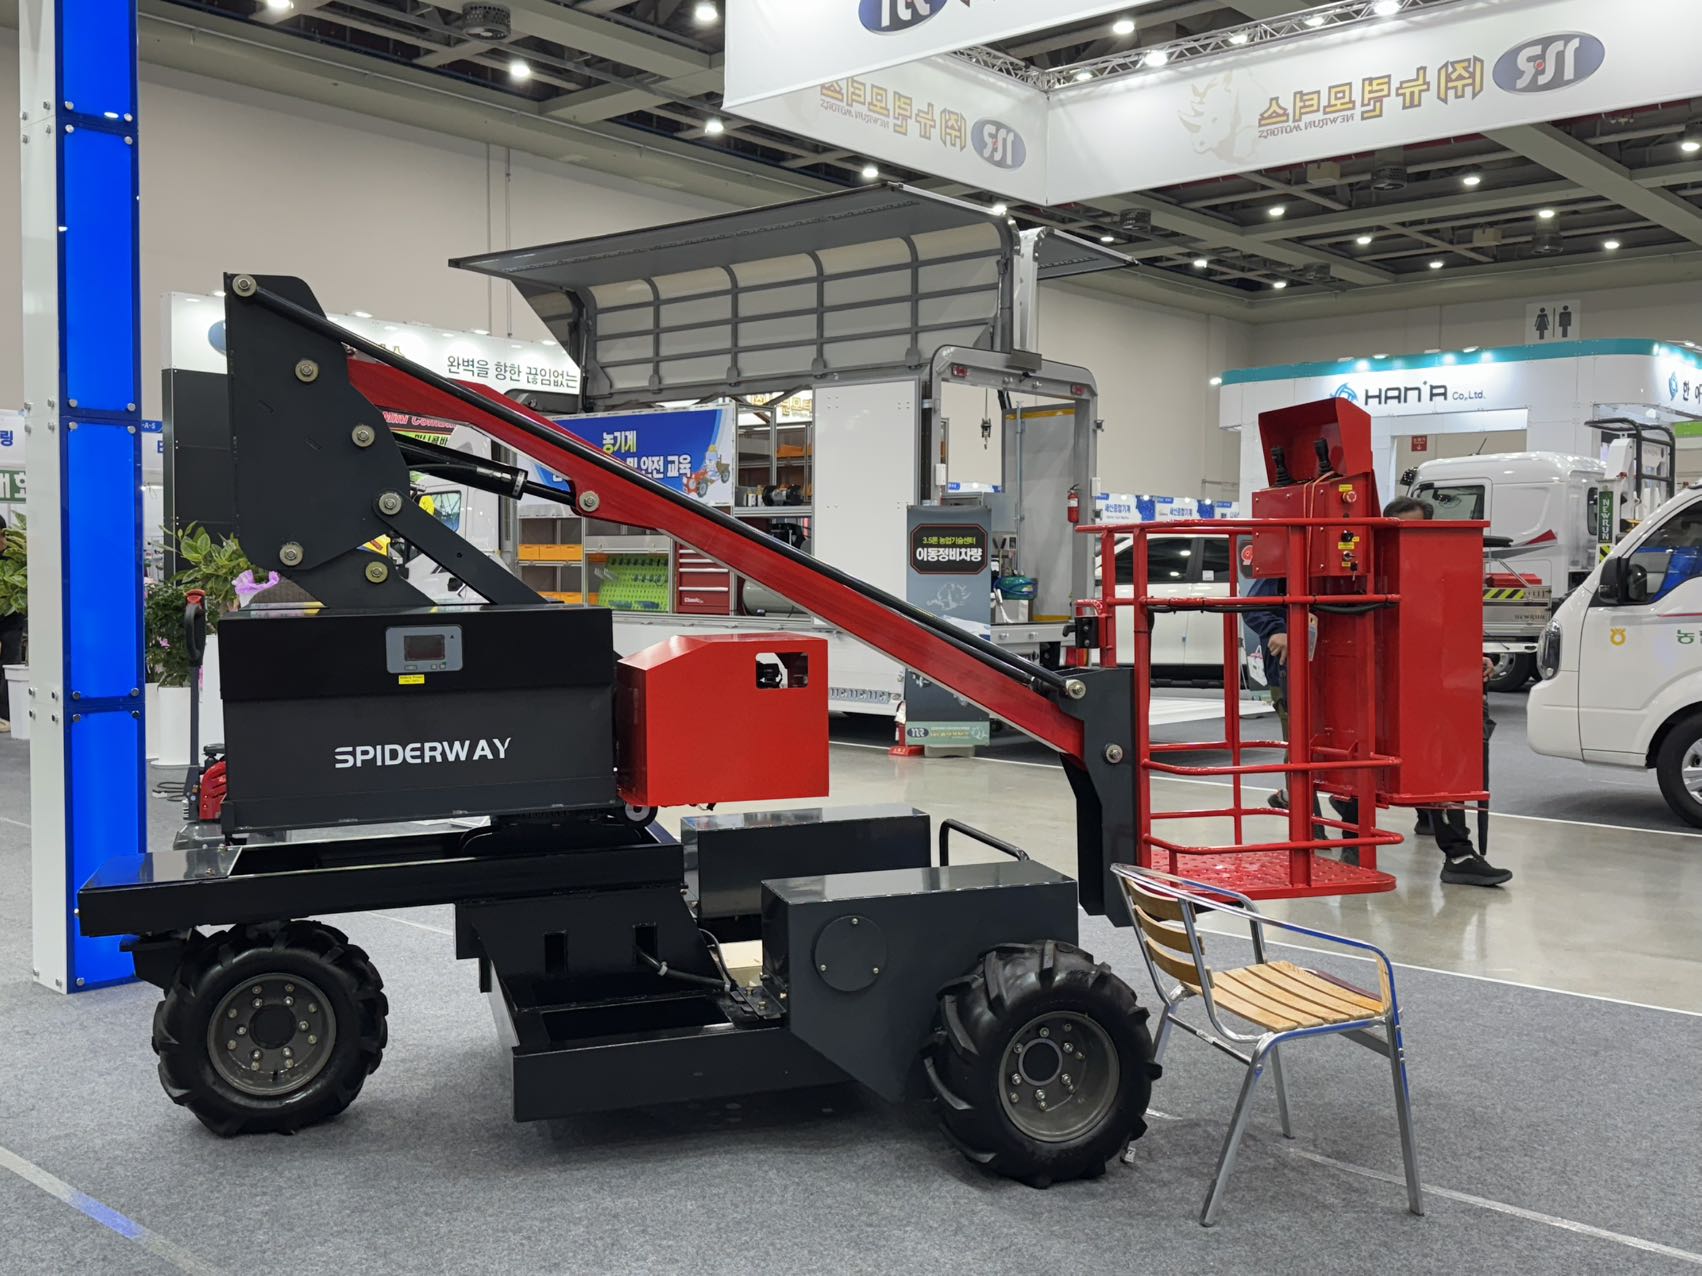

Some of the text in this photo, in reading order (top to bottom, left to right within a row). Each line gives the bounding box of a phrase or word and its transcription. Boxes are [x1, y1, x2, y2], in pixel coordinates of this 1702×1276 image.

[447, 355, 578, 389] 완벽을 향한 끊임없는
[602, 430, 637, 454] 농기계
[640, 455, 664, 479] 안전
[667, 454, 692, 478] 교육
[1601, 498, 1610, 540] NEWRUN
[916, 547, 983, 562] 이동정비차량
[334, 737, 511, 769] SPIDERWAY
